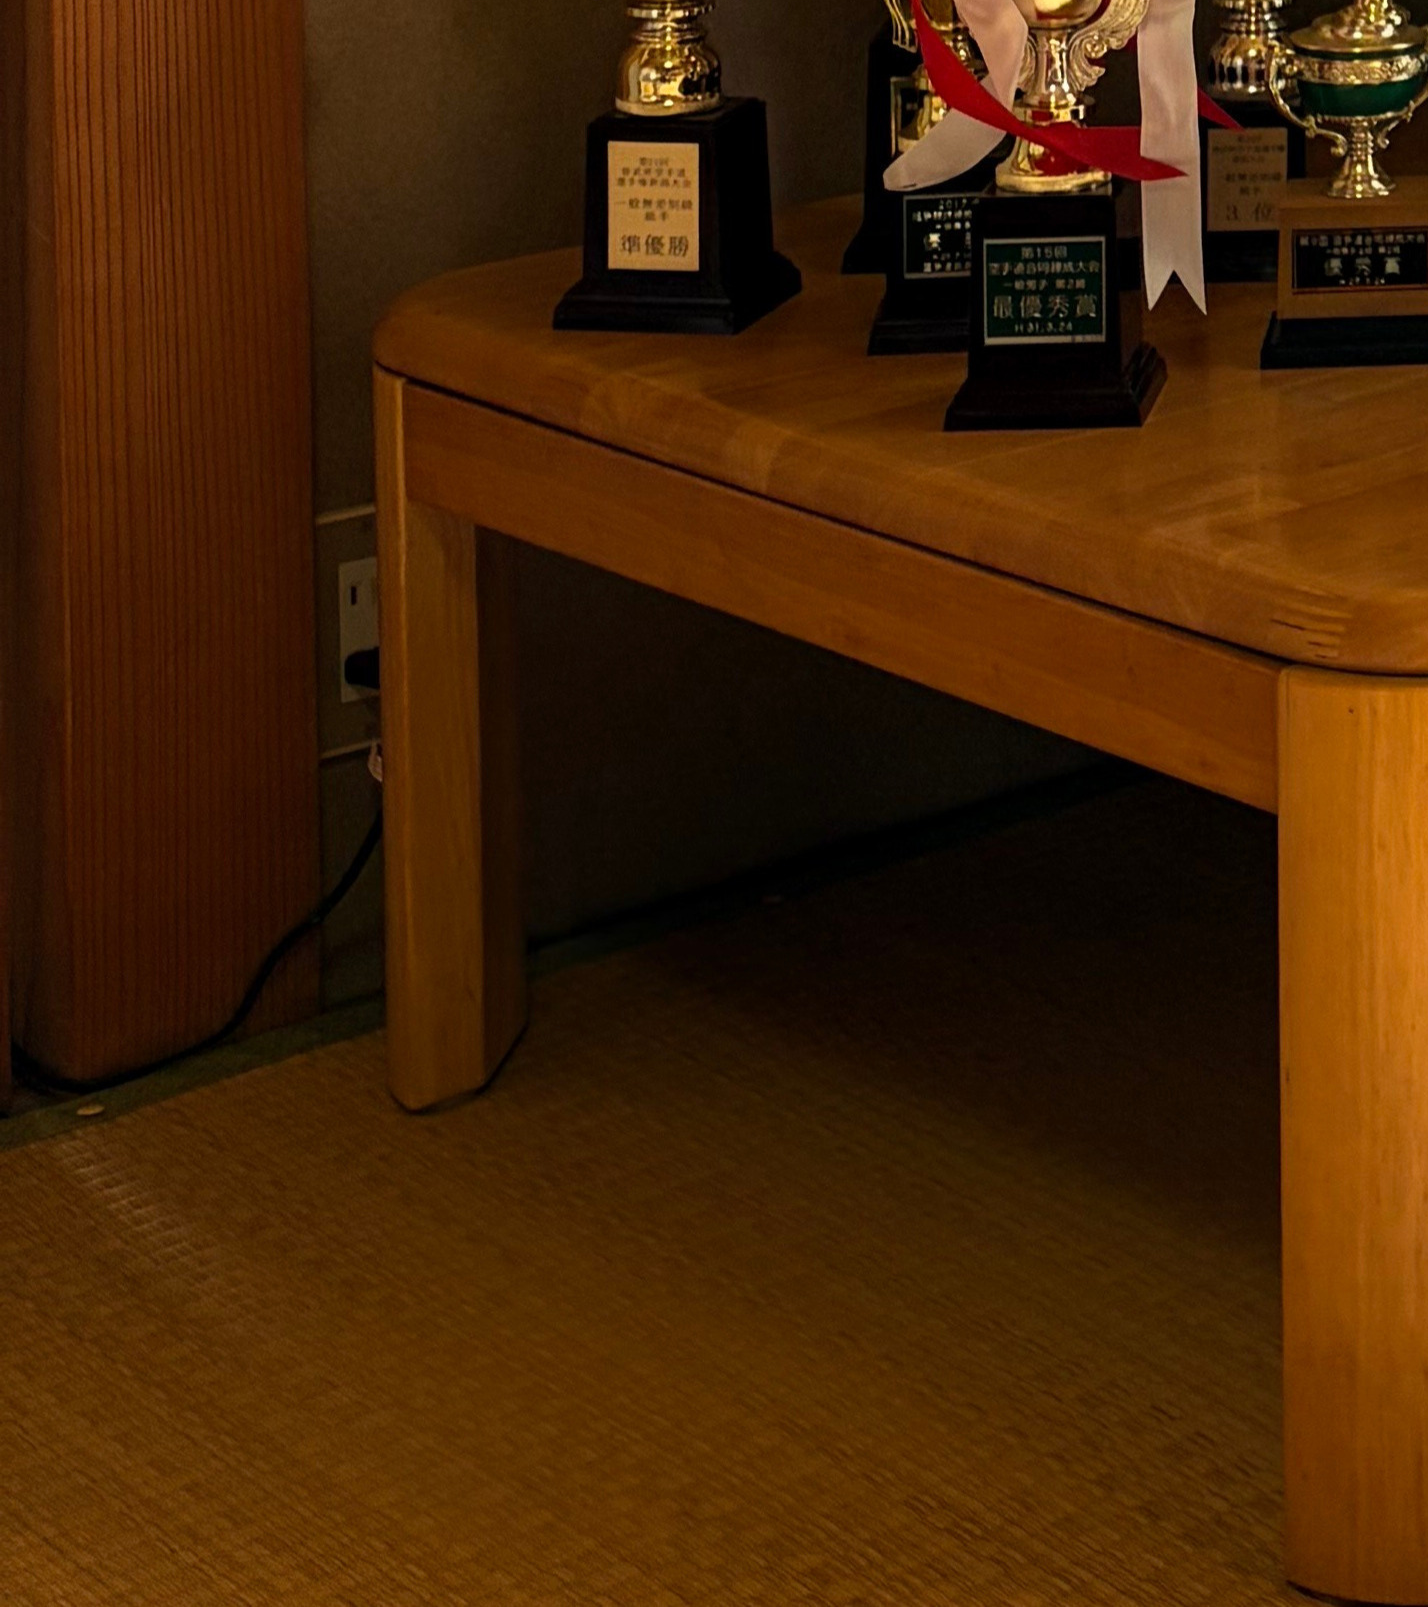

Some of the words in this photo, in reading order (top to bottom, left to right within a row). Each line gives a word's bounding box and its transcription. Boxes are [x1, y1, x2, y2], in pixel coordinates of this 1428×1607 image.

[621, 233, 690, 257] 準優勝
[993, 294, 1098, 319] 最優秀賞
